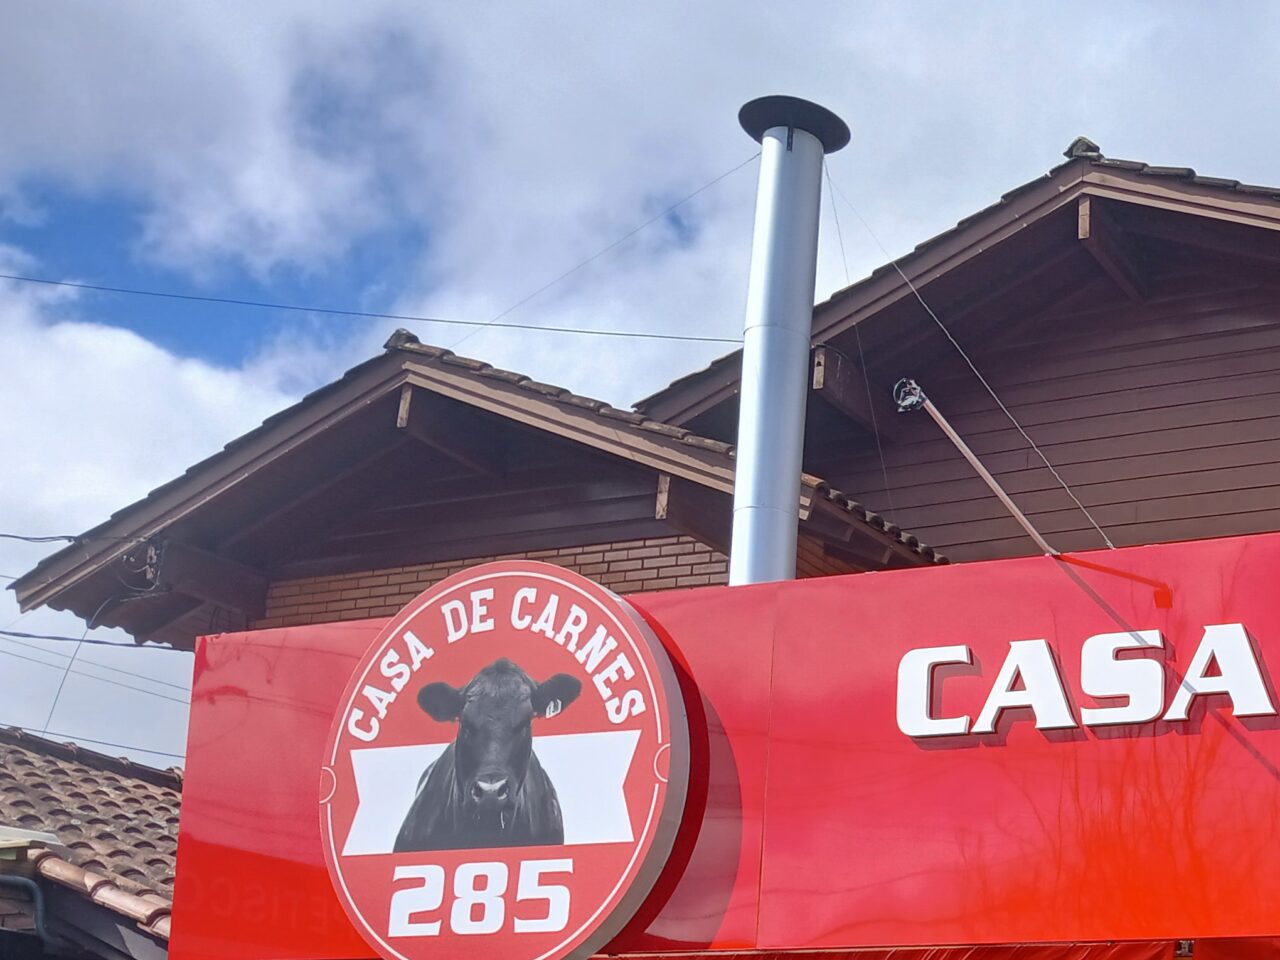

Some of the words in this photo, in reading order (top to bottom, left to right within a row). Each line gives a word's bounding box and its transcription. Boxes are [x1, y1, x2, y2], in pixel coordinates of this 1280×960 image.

[348, 630, 435, 742] CASA
[441, 587, 495, 643] DE
[510, 587, 646, 724] CARNES
[896, 622, 1278, 738] CASA
[388, 858, 574, 937] 285
